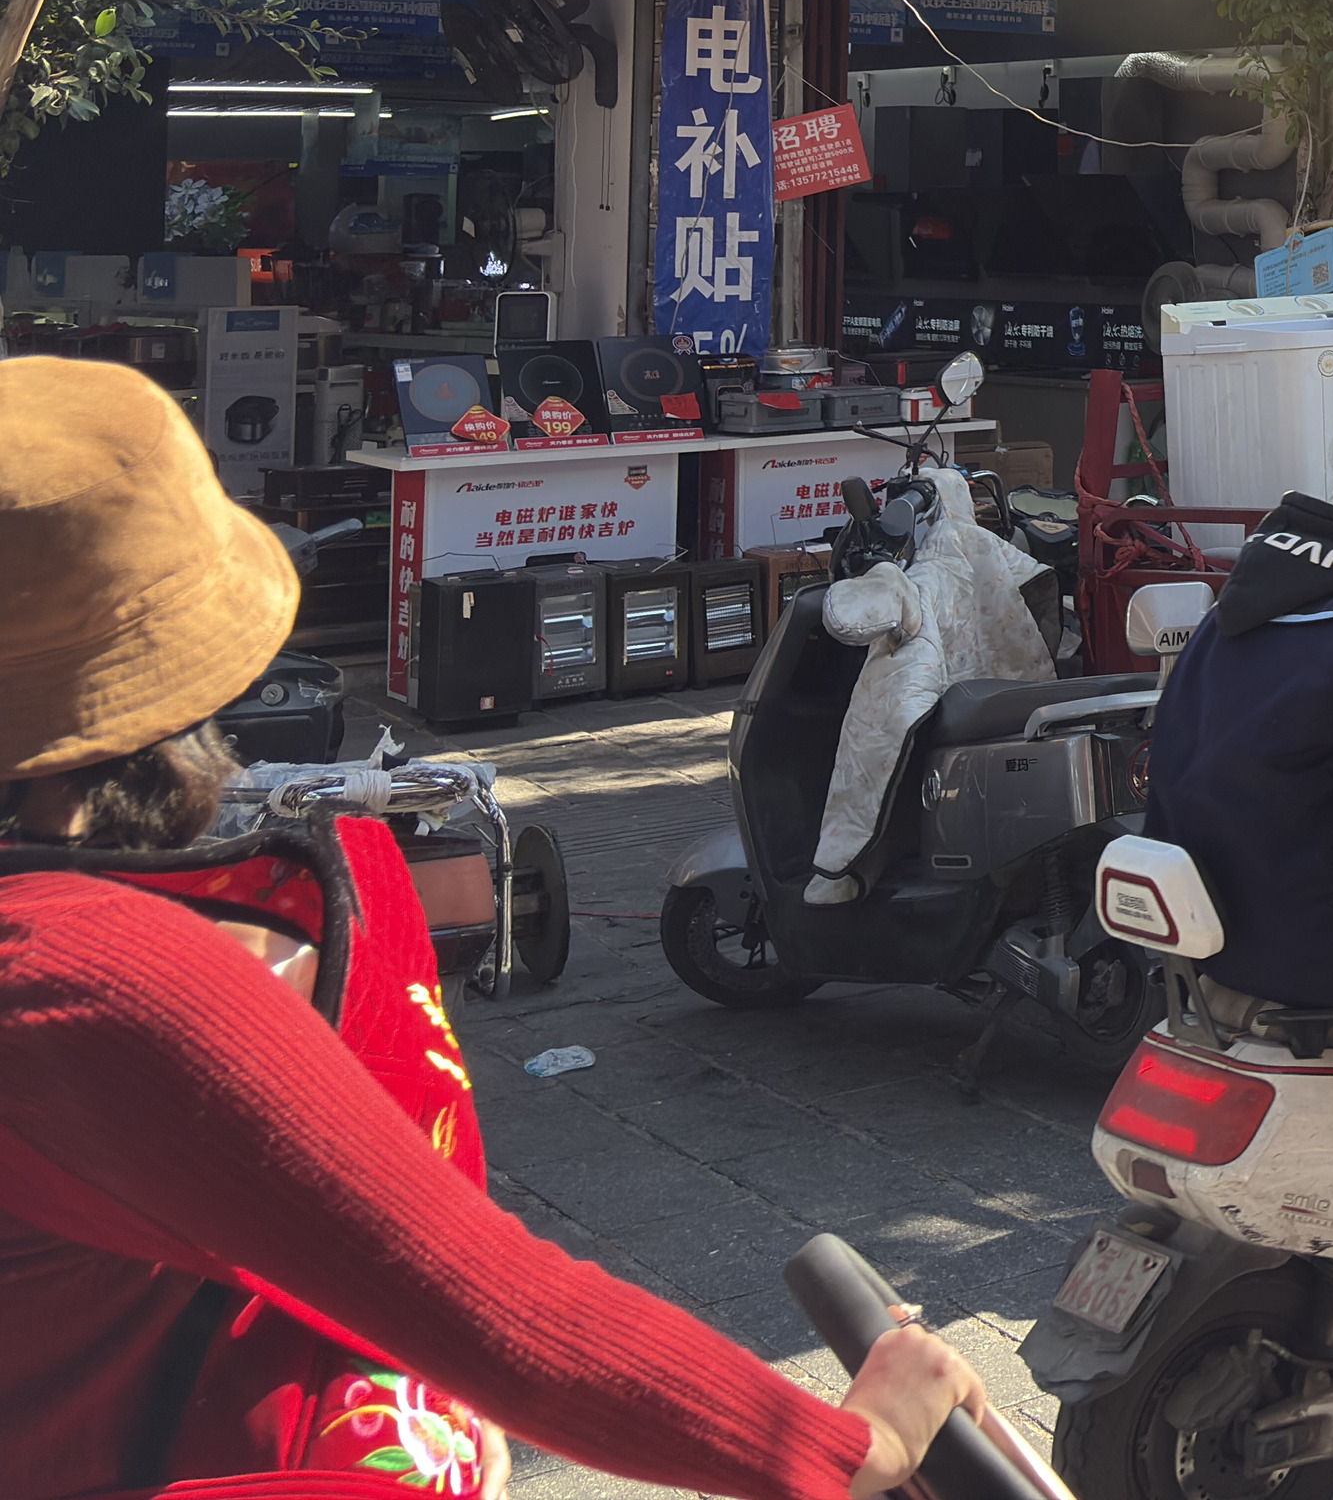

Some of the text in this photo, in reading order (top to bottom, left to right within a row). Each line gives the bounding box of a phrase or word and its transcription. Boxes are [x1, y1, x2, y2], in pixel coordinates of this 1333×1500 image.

[772, 113, 842, 153] 招聘
[775, 163, 860, 192] 话:13577215448
[541, 409, 572, 421] 换购价
[463, 420, 496, 432] 换购价
[543, 421, 572, 435] 199
[494, 501, 619, 526] 电磁炉谁家快
[474, 519, 636, 548] 当然是耐的快吉炉
[1158, 630, 1190, 648] AIM
[1005, 758, 1029, 773] 爱玛
